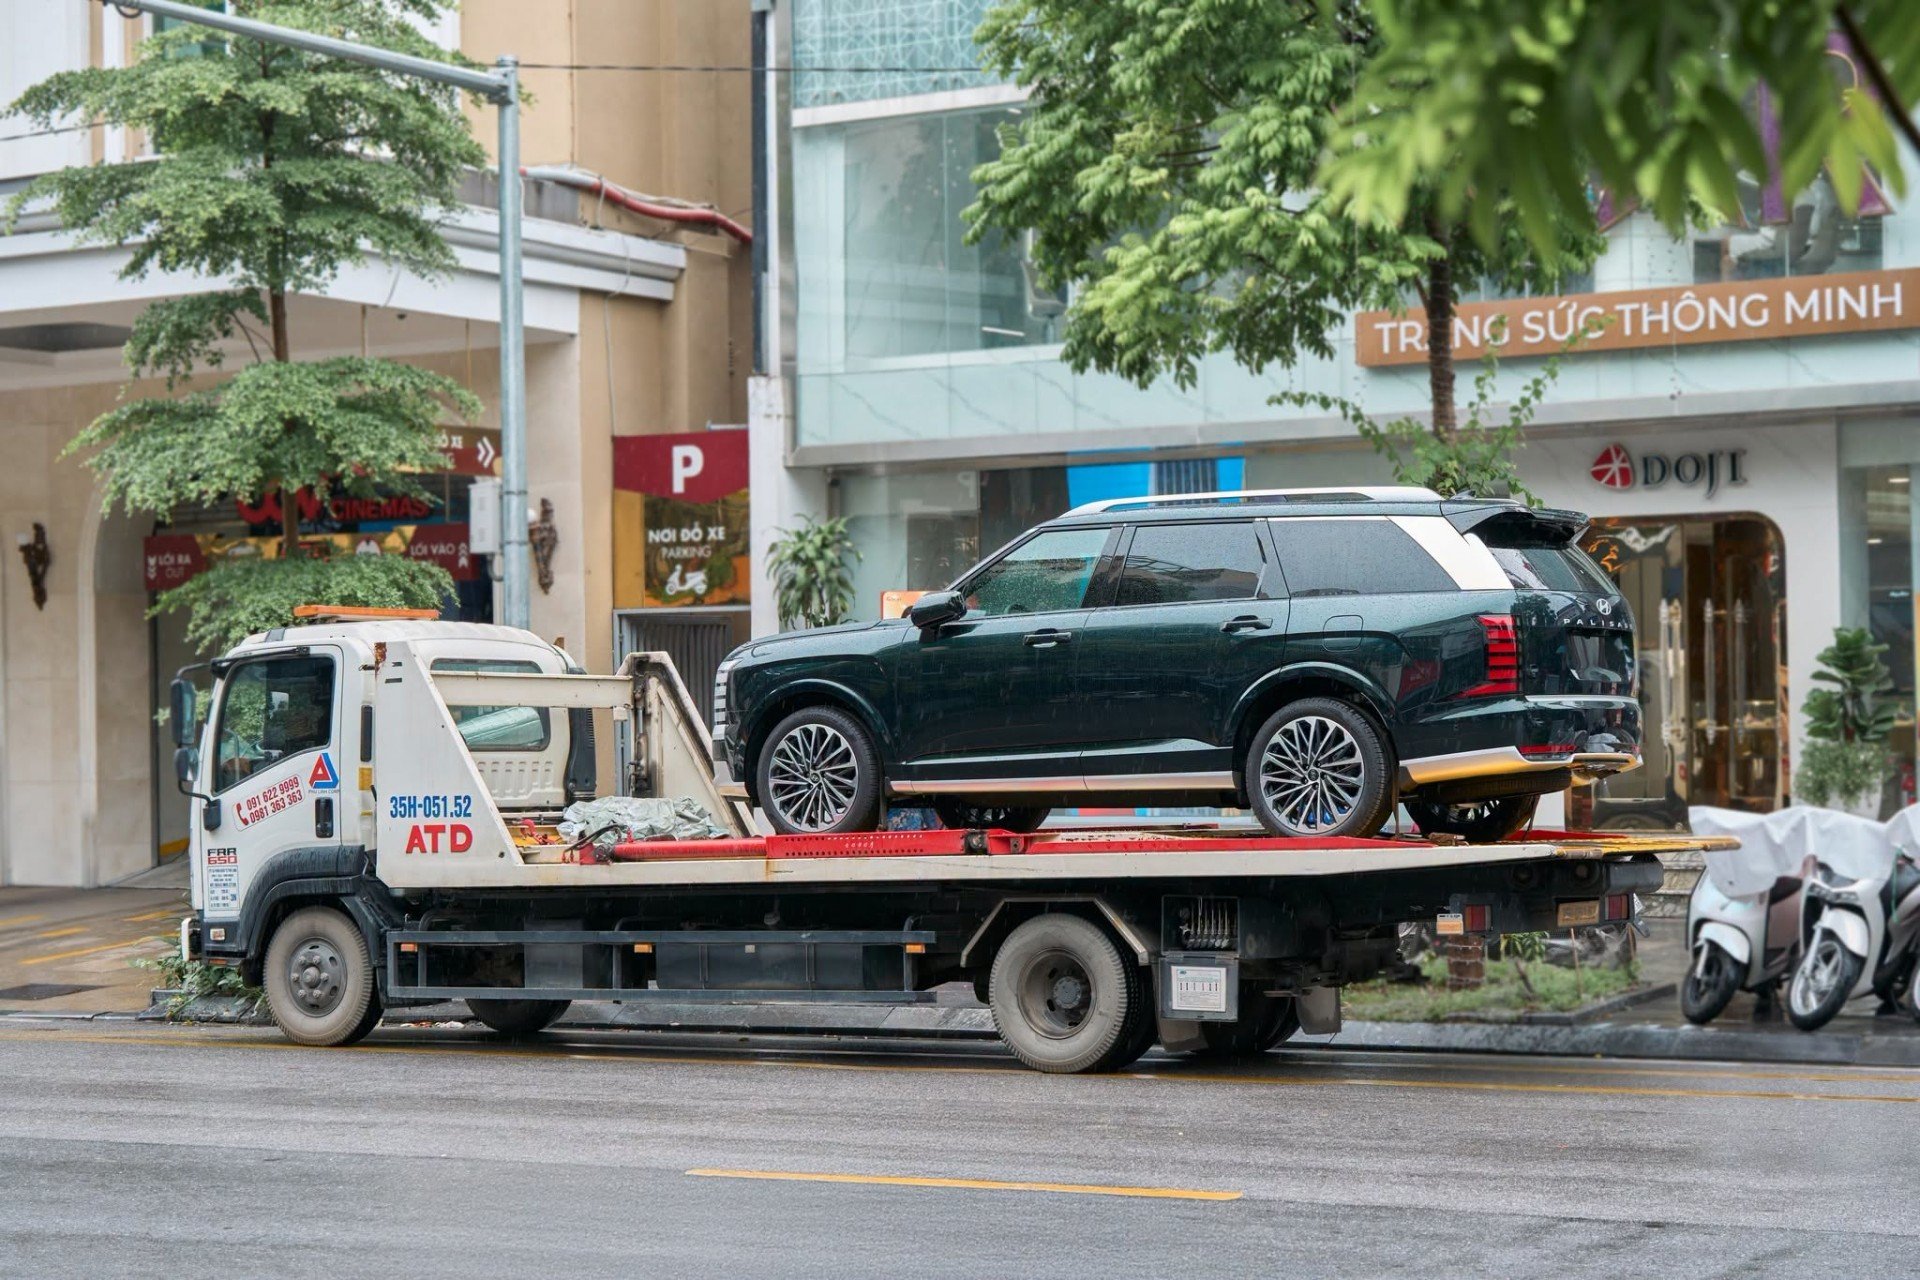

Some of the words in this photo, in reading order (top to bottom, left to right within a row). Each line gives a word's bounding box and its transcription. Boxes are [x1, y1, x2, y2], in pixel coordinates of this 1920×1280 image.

[1374, 314, 1510, 354] TRNG
[1522, 300, 1604, 344] SỨC
[1615, 292, 1769, 336] THÔNG
[1784, 282, 1903, 324] MINH
[672, 445, 704, 494] P
[1642, 448, 1748, 498] DOJI
[330, 495, 430, 521] CINEMAS
[707, 526, 726, 541] XE
[661, 545, 712, 559] PARKING
[246, 795, 262, 811] 091
[263, 787, 279, 803] 622
[278, 776, 300, 795] 9999
[249, 806, 270, 824] 0981
[270, 797, 286, 814] 363
[286, 789, 303, 806] 363
[390, 794, 472, 819] 35H-051.52
[405, 824, 474, 854] ATD
[207, 856, 238, 865] 650
